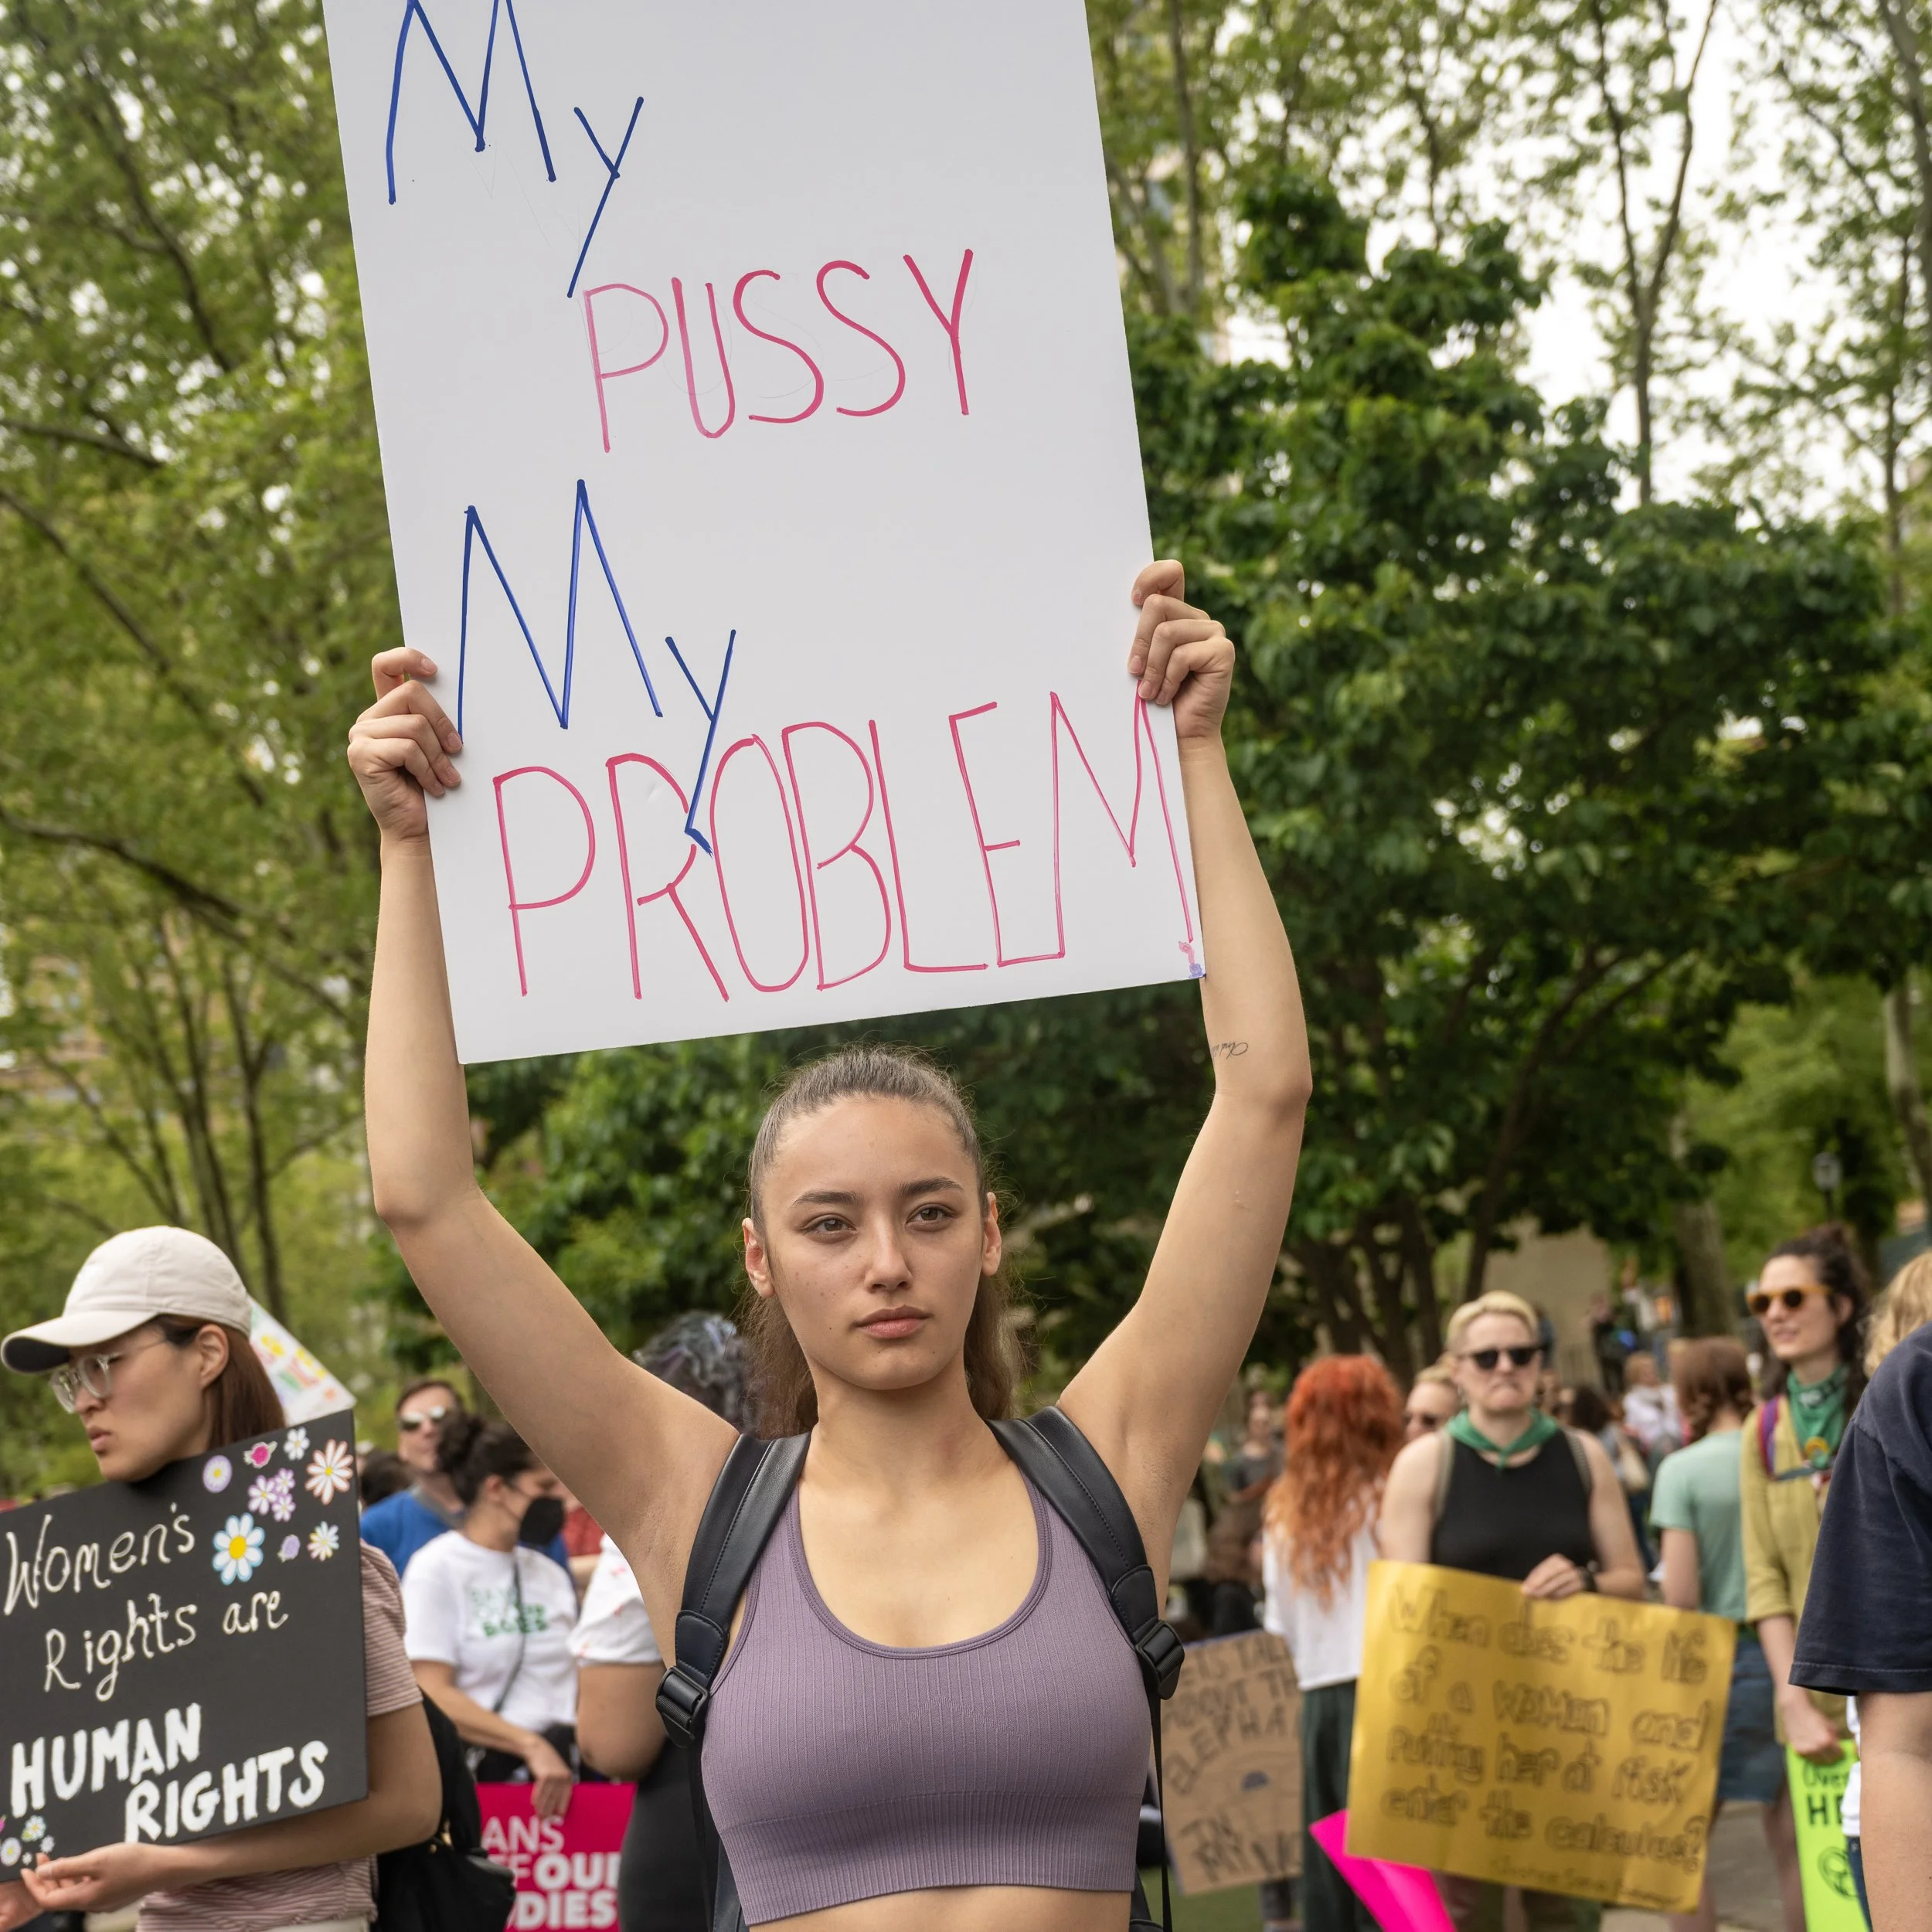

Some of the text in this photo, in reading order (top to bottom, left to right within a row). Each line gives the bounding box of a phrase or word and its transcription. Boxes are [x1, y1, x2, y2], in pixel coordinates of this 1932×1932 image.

[583, 249, 974, 454] PUSSY
[457, 479, 736, 855] My
[493, 680, 1194, 1002] PROBLEM
[4, 1502, 196, 1616] Women's
[44, 1590, 289, 1701] Rights are
[10, 1702, 202, 1818] HUMAN
[124, 1740, 329, 1844] RIGHTS
[506, 1890, 618, 1930] DIES
